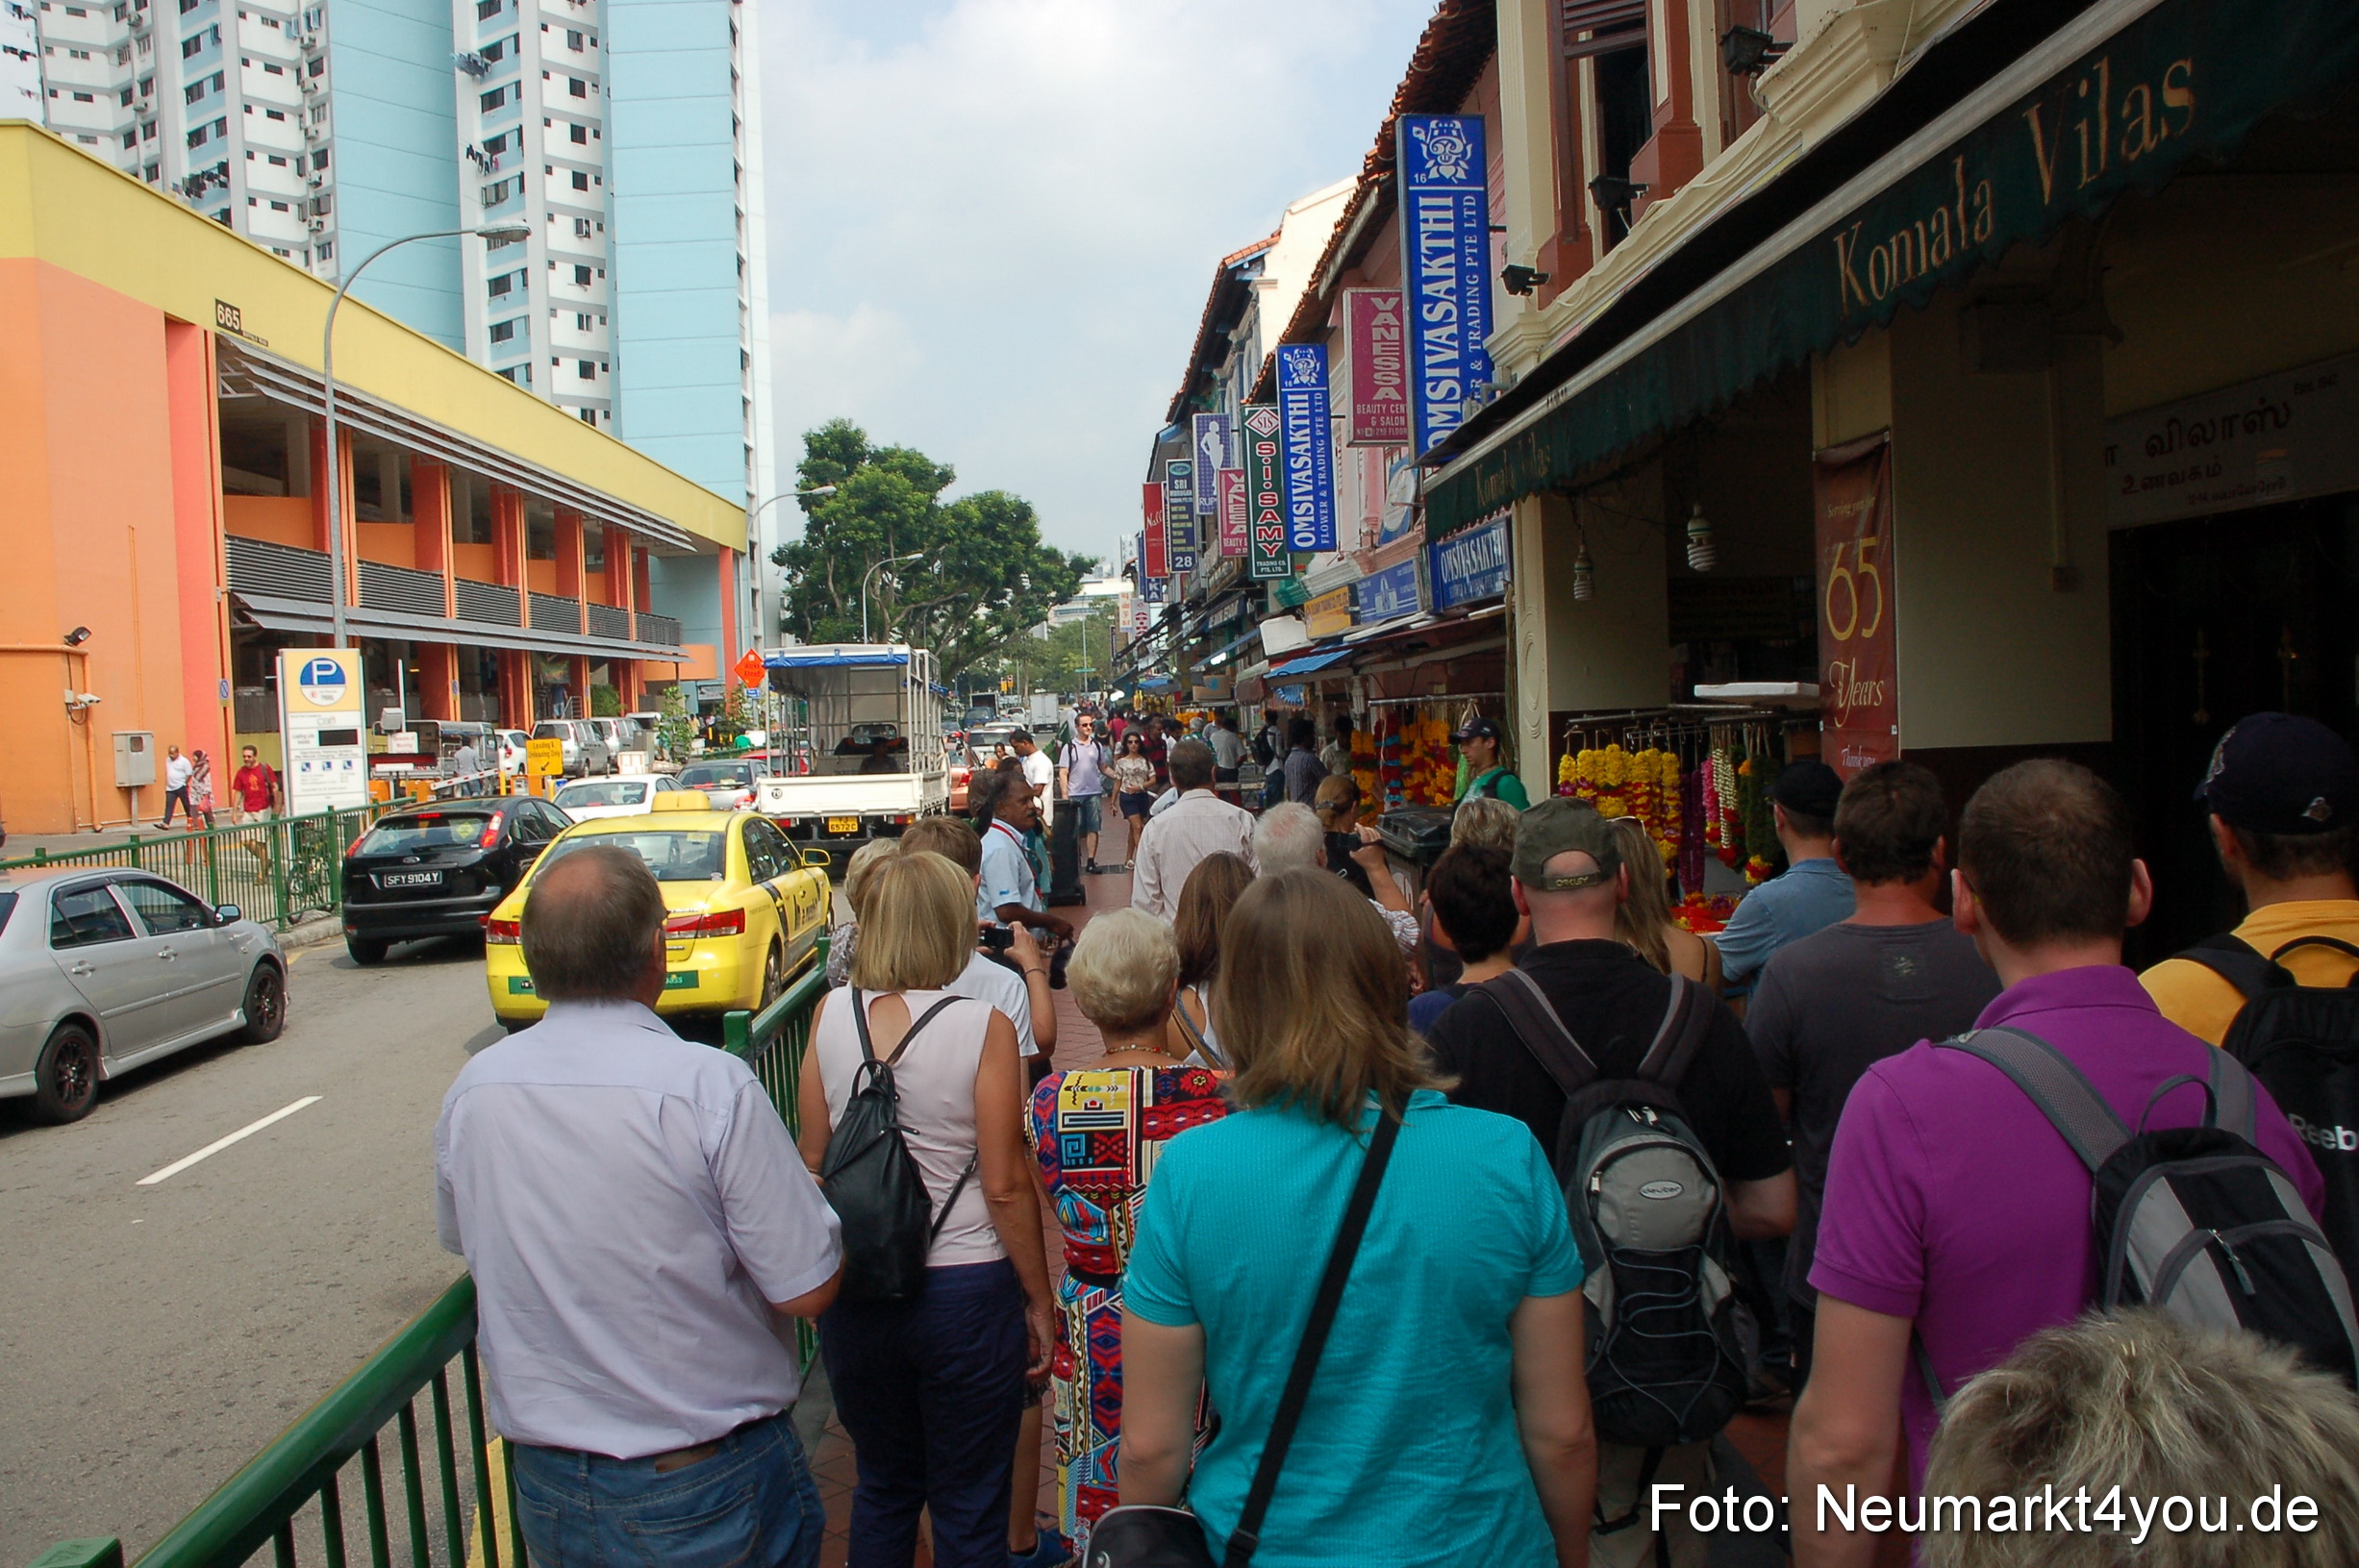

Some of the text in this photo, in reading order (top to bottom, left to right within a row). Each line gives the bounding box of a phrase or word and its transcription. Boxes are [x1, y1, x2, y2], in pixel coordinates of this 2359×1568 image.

[1413, 173, 1427, 184] 16
[1834, 55, 2195, 321] Komala Vilas
[1463, 195, 1477, 228] LTD
[1465, 235, 1478, 265] PTE
[217, 303, 240, 331] 665
[1467, 275, 1481, 353] TRADING
[1370, 297, 1402, 400] VANESSA
[1469, 359, 1483, 373] &
[1315, 392, 1323, 411] LTD
[1357, 404, 1407, 414] BEAUTY CEN
[1257, 415, 1274, 429] SIS
[1316, 414, 1324, 436] PTE
[1380, 416, 1405, 426] SALON
[1288, 394, 1316, 548] OMSIVASAKTHI
[1317, 439, 1327, 486] TRADING
[1174, 479, 1188, 489] SRI
[1321, 502, 1330, 544] FLOWER
[1175, 557, 1192, 568] 28
[1441, 528, 1506, 584] OMSIVASAKTHI
[1826, 537, 1882, 641] 65
[312, 660, 338, 685] P
[1829, 658, 1884, 728] Years
